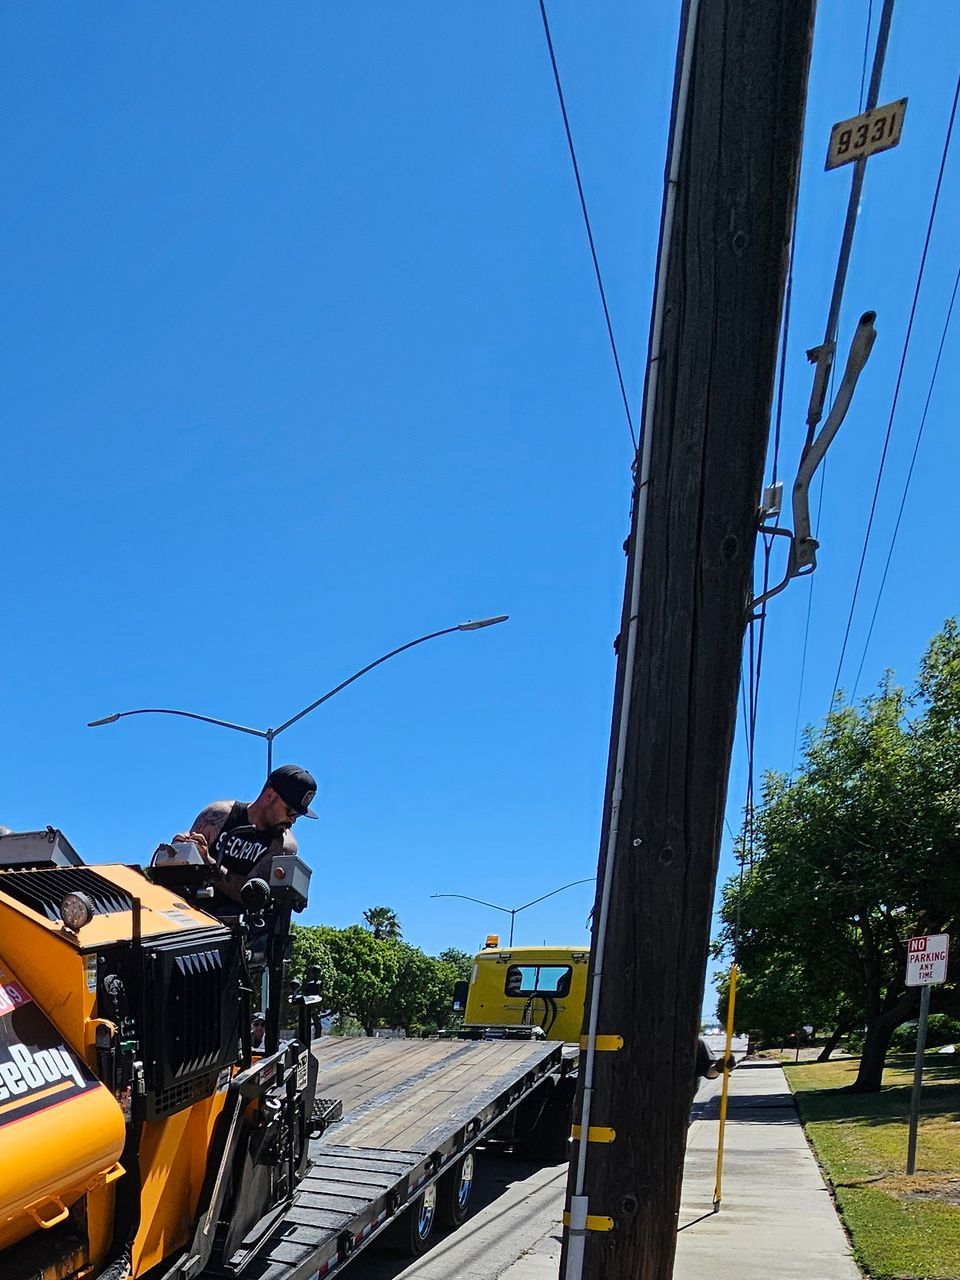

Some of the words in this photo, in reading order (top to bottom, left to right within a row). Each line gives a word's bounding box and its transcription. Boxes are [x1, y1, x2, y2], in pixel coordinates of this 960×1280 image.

[837, 112, 896, 155] 9331
[911, 939, 925, 951] NO
[910, 951, 945, 963] PARKING
[918, 971, 933, 979] TIME
